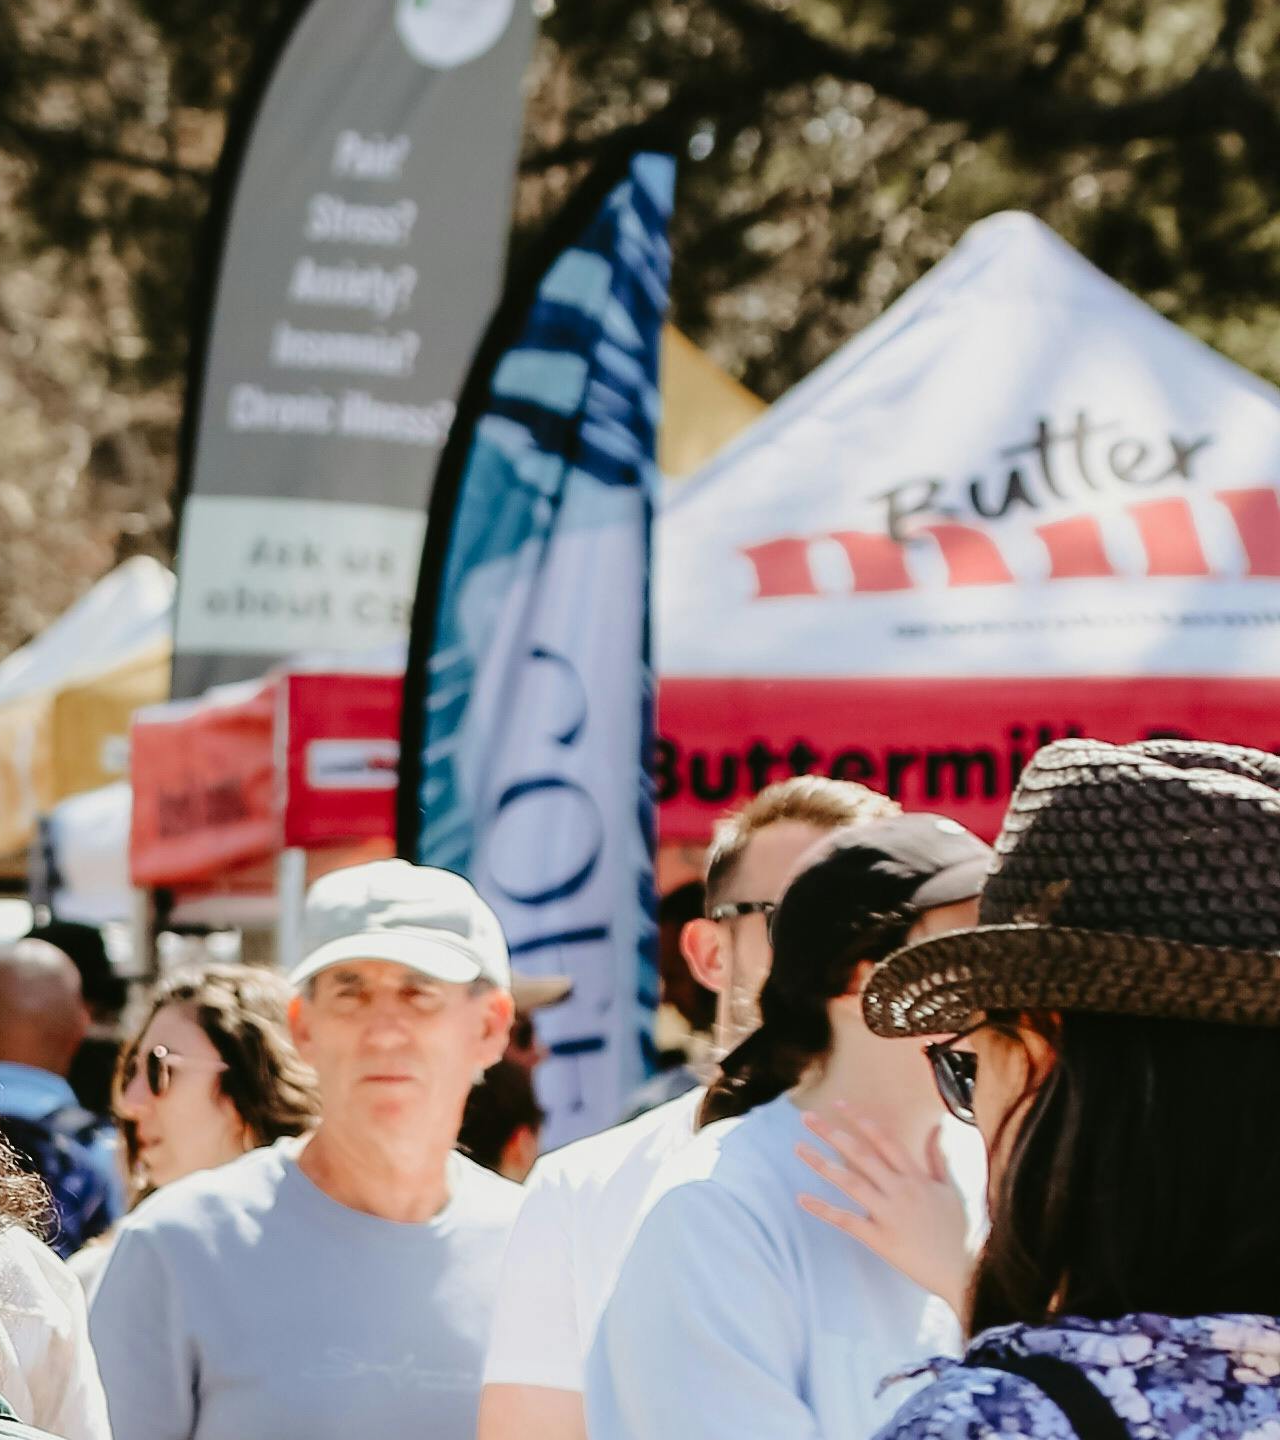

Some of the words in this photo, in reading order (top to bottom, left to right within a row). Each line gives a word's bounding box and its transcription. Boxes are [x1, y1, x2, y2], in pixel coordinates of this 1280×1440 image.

[308, 192, 418, 246] Stress?
[290, 256, 418, 318] Anxiety?
[873, 409, 1212, 544] Butter
[204, 586, 332, 618] about
